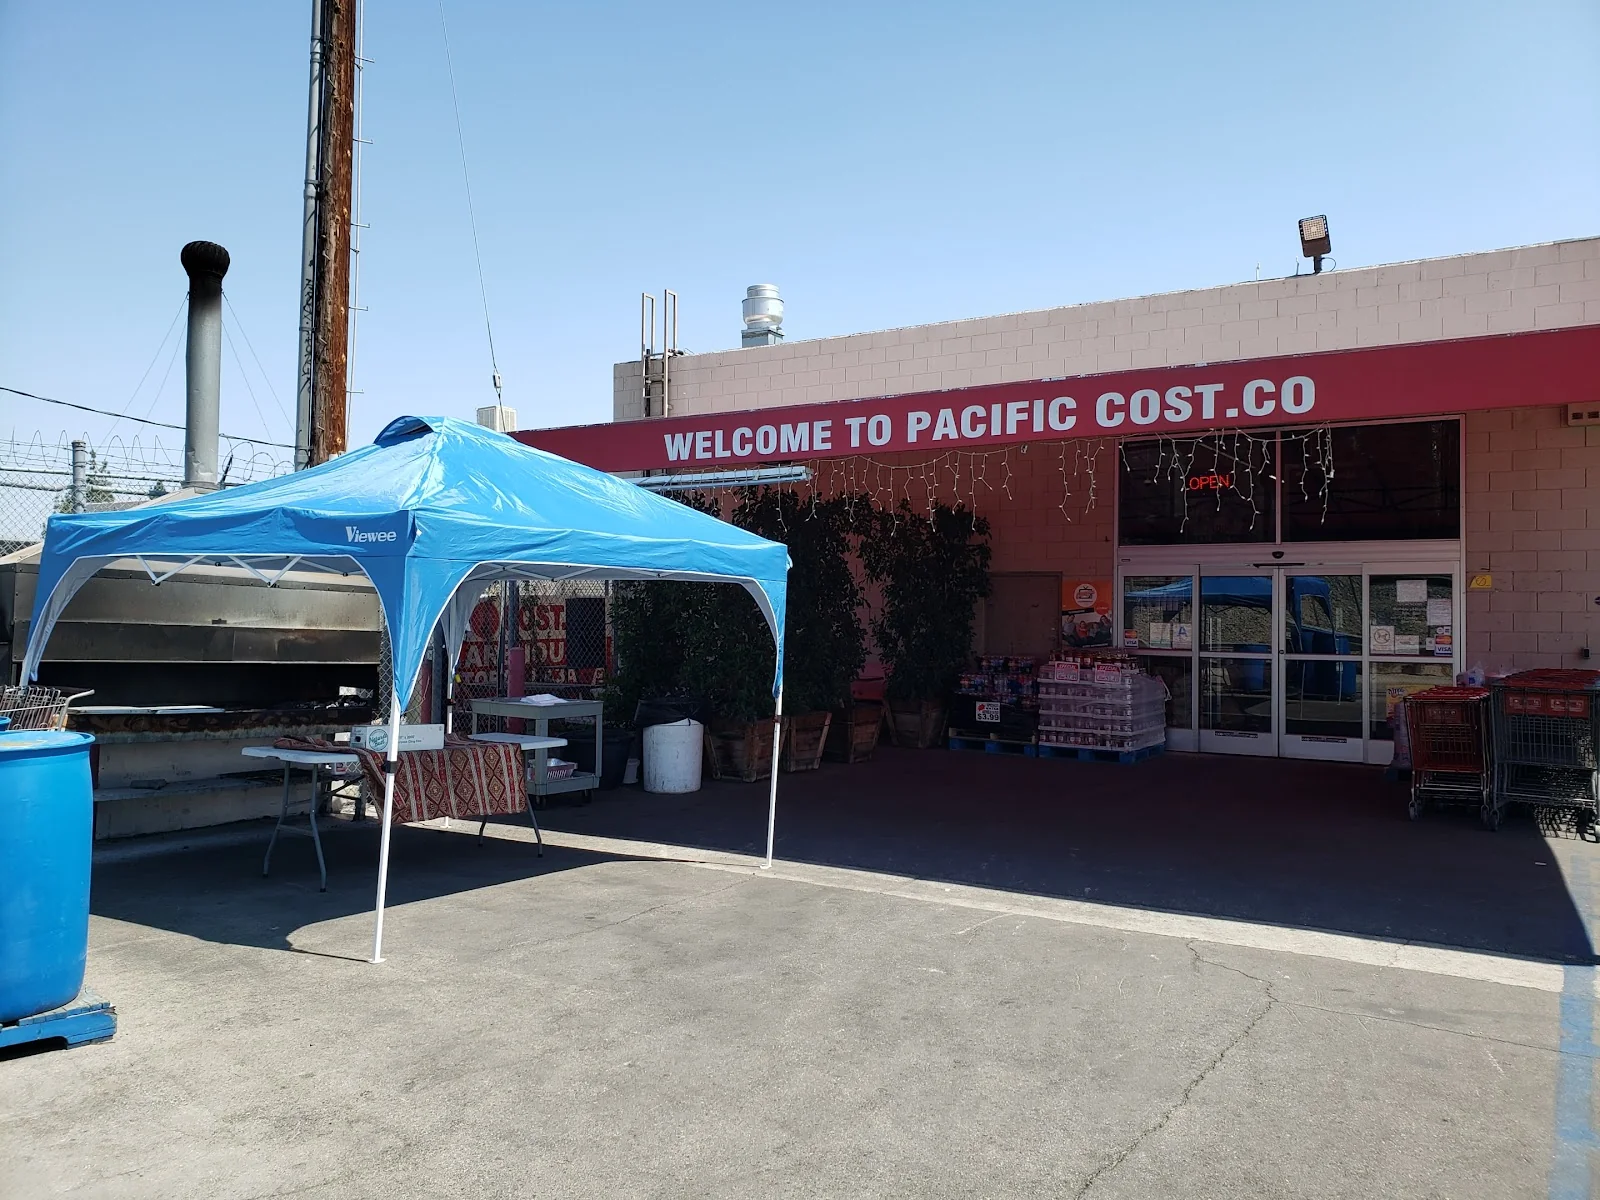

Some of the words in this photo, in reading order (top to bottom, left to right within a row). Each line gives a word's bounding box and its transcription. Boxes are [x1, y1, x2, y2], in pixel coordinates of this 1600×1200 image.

[664, 420, 832, 461] WELCOME
[845, 414, 892, 448] TO
[907, 396, 1077, 443] PACIFIC
[1095, 375, 1316, 428] COST.CO
[1189, 474, 1230, 490] OPEN
[345, 526, 397, 542] Viewee
[977, 713, 999, 721] $3.99
